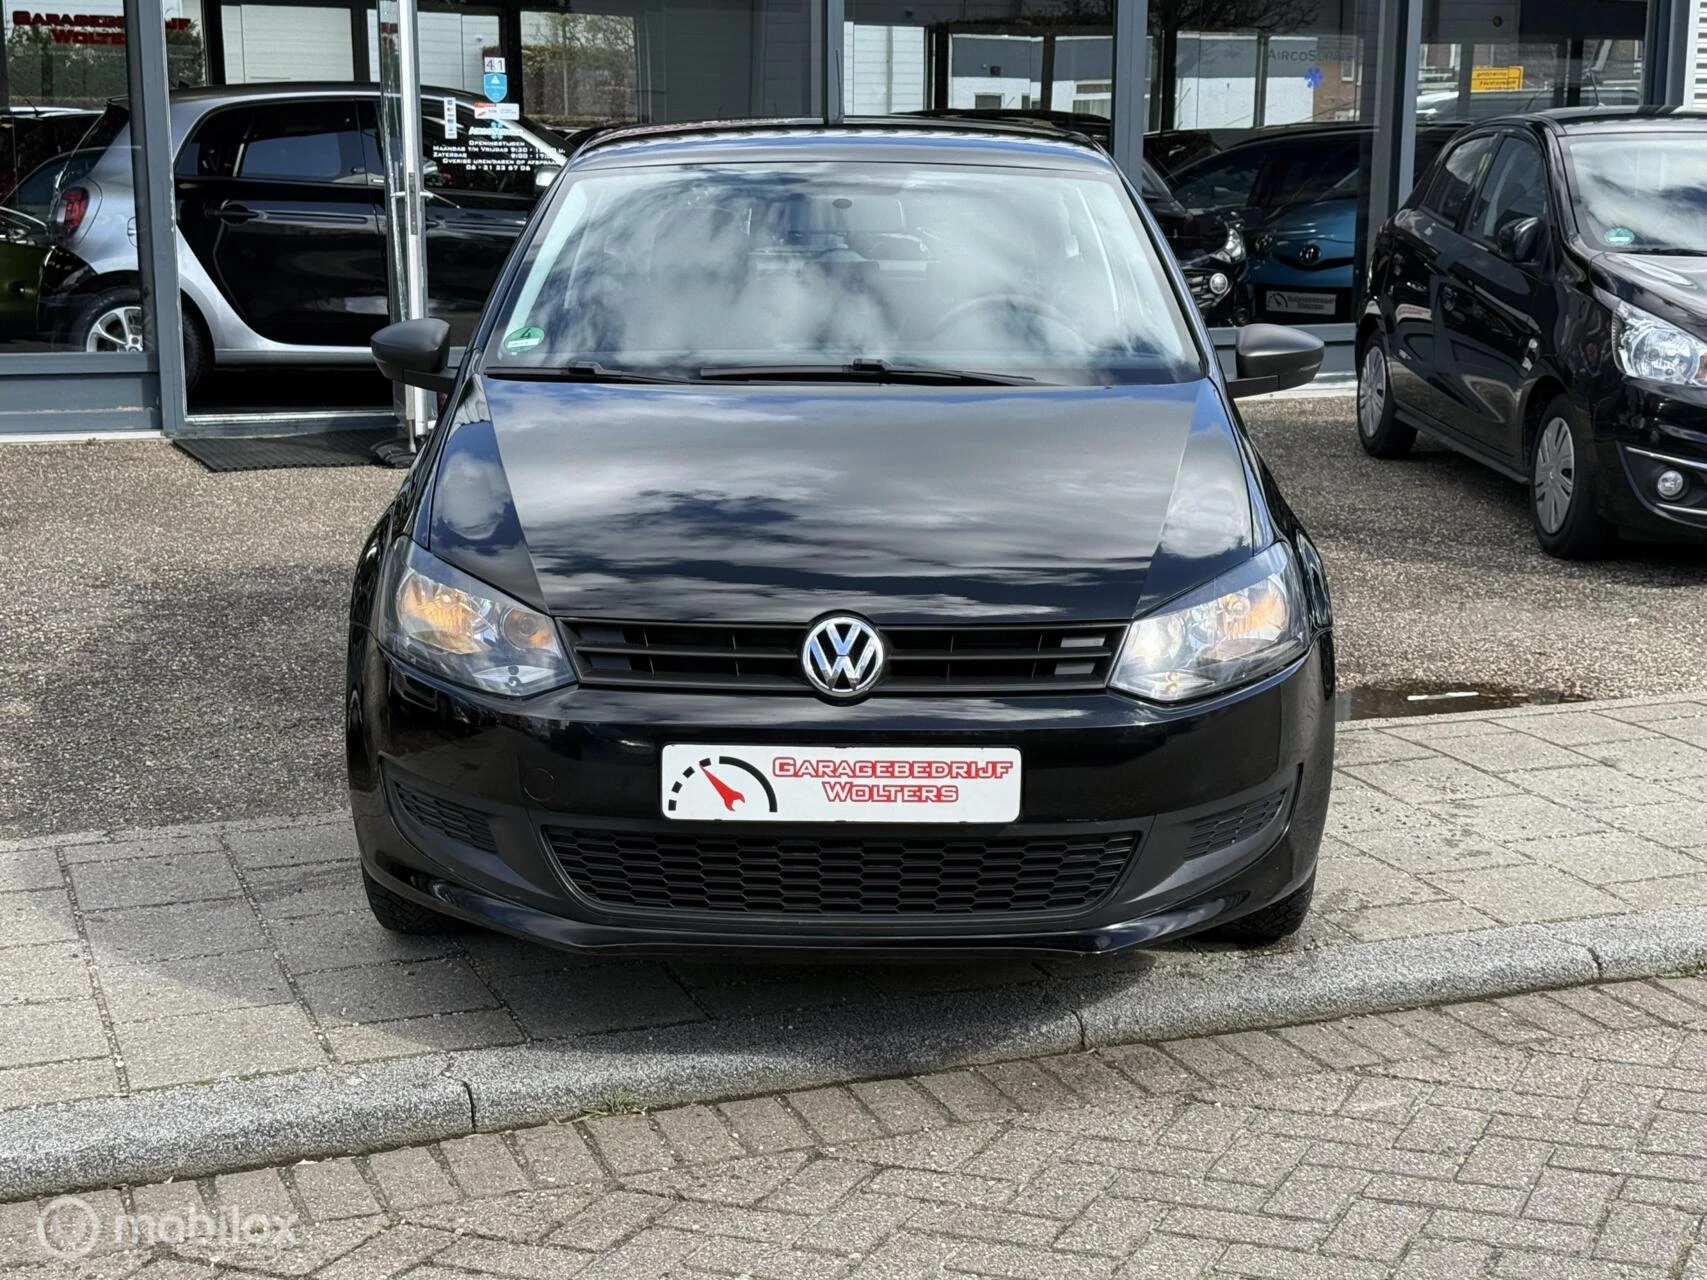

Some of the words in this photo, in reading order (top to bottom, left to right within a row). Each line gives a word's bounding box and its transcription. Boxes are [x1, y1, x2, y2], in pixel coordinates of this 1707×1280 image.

[486, 58, 504, 71] 41
[520, 327, 532, 339] 4
[773, 756, 1013, 779] GARAGEBEDRIJF
[822, 781, 959, 803] WOLTERS
